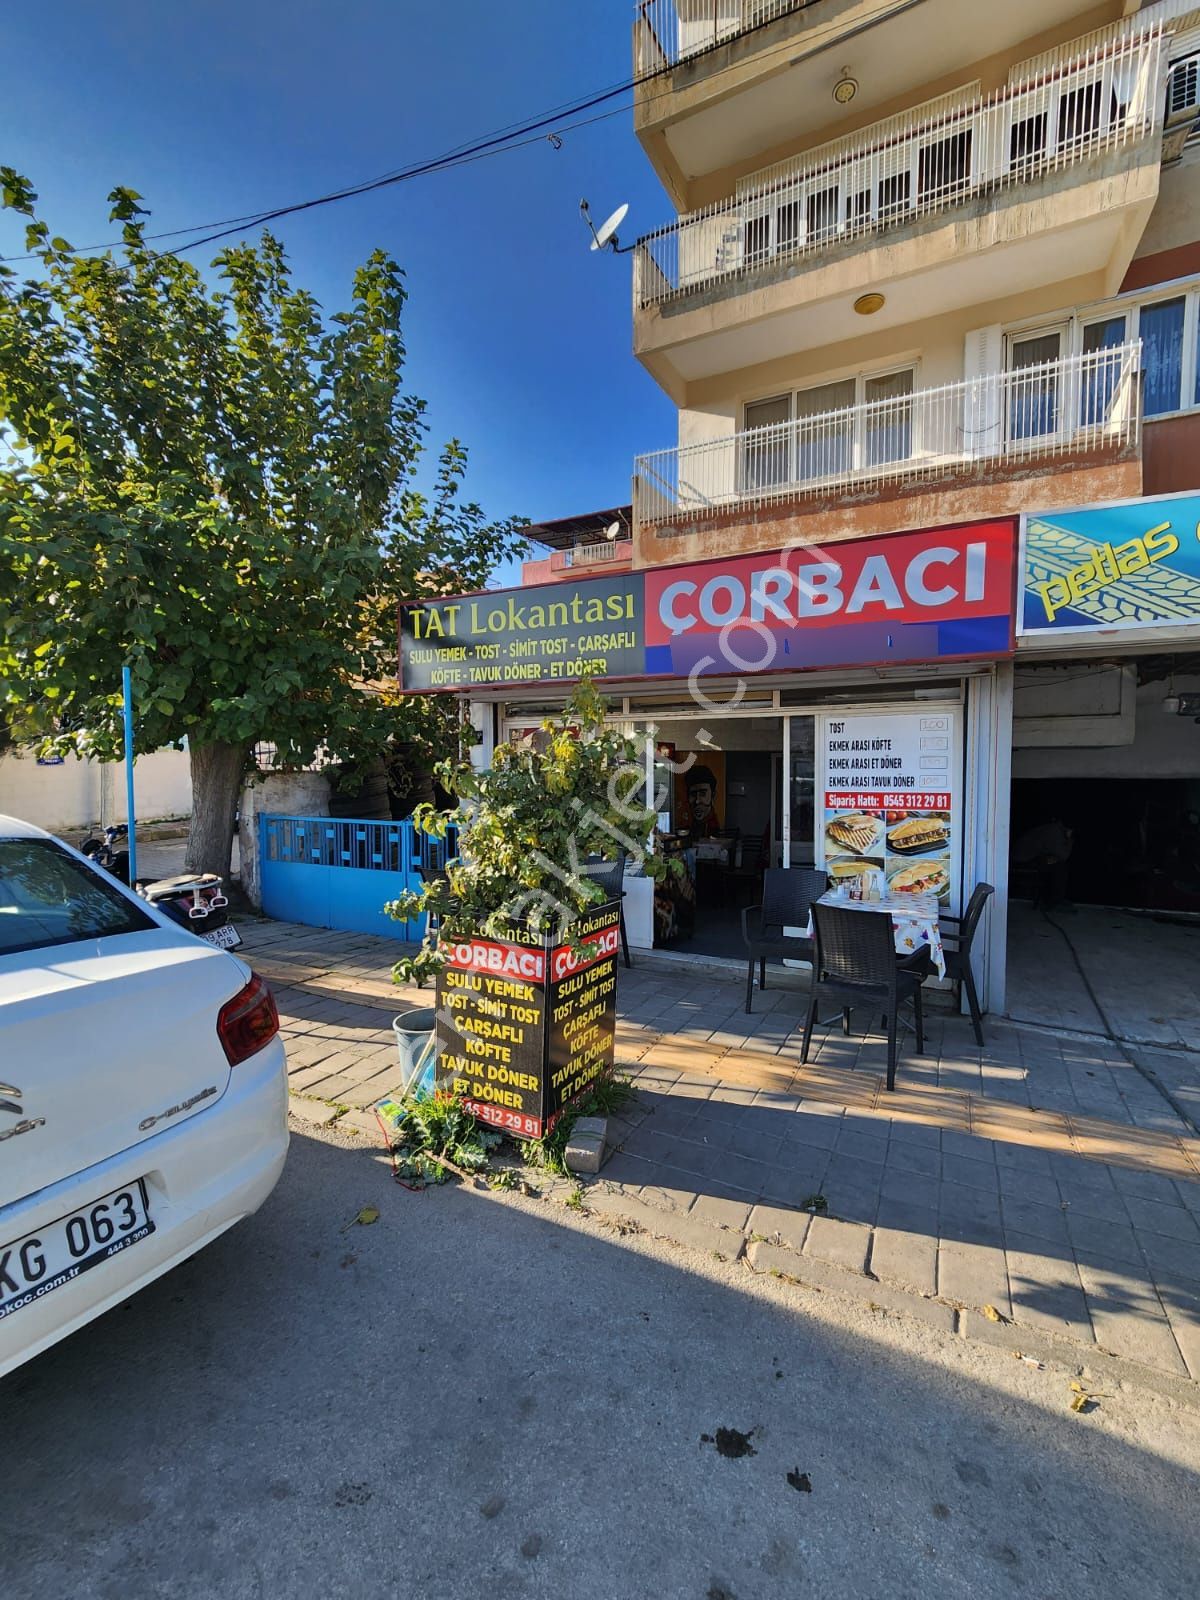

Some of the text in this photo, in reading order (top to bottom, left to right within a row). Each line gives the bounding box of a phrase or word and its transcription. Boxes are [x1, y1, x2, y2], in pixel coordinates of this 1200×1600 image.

[1040, 520, 1180, 622] petlas
[658, 542, 987, 635] ÇORBACI
[409, 592, 635, 639] TAT Lokantası
[410, 650, 433, 665] SULU
[434, 646, 467, 663] YEMEK
[475, 644, 500, 660] TOST
[509, 638, 539, 658] SİMİT
[540, 638, 568, 656] TOST
[578, 631, 636, 654] ÇARŞAFLI
[431, 666, 462, 684] KÖFTE
[469, 664, 502, 682] TAVUK
[504, 661, 541, 680] DÖNER
[550, 661, 566, 678] ET
[566, 657, 608, 676] DÖNER
[829, 722, 845, 734] TOST
[829, 736, 892, 752] EKMEK ARASI KÖFTE
[829, 754, 902, 770] EKMEK ARASI ET DÖNER
[829, 776, 850, 788] EKMEK
[851, 776, 870, 788] ARASI
[872, 776, 892, 788] TAVUK
[893, 773, 915, 788] DÖNER
[828, 794, 856, 808] Sipariş
[883, 795, 904, 807] 0545
[906, 795, 922, 807] 312
[924, 795, 934, 807] 29
[936, 795, 947, 808] 81
[446, 972, 536, 1002] SULU YEMEK
[558, 960, 613, 999] SULU YEMEK
[441, 991, 468, 1010] TOST
[477, 996, 508, 1018] SİMİT
[510, 1004, 540, 1025] TOST
[554, 999, 574, 1023] TOST
[579, 986, 598, 1008] SİMİT
[599, 977, 616, 997] TOST
[454, 1016, 524, 1044] ÇARŞAFLI
[562, 1000, 606, 1040] ÇARŞAFLI
[466, 1038, 511, 1063] KÖFTE
[570, 1024, 599, 1055] KÖFTE
[440, 1053, 539, 1092] TAVUK DÖNER
[552, 1034, 613, 1089] TAVUK DÖNER
[452, 1077, 523, 1110] ET DÖNER
[561, 1081, 574, 1104] ET
[574, 1058, 604, 1093] DÖNER
[482, 1105, 503, 1124] 312
[505, 1113, 522, 1128] 29
[524, 1118, 539, 1134] 81
[65, 1192, 137, 1258] 063
[107, 1242, 124, 1256] 444
[125, 1238, 132, 1246] 3
[132, 1228, 149, 1242] 300
